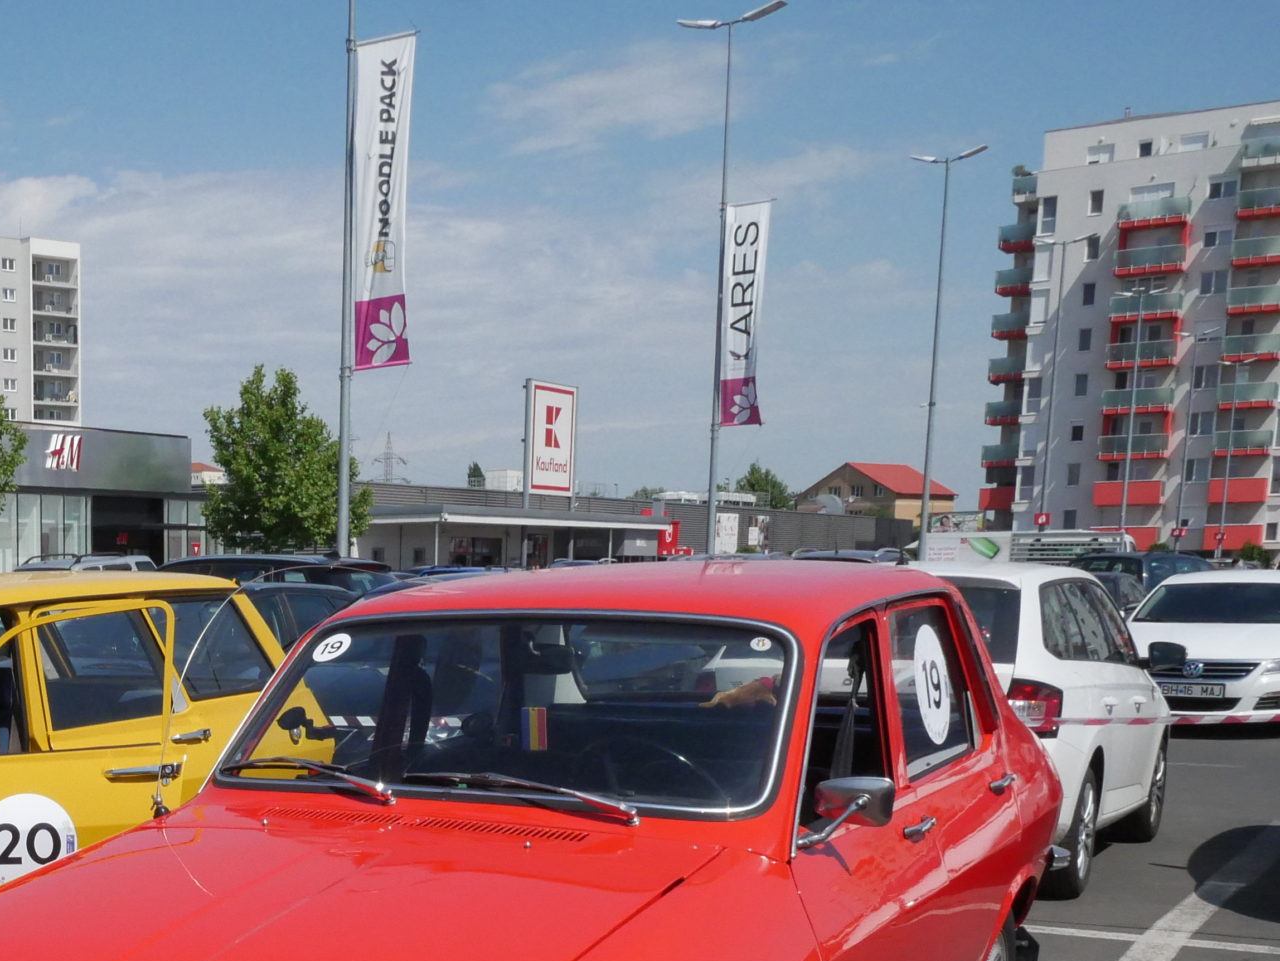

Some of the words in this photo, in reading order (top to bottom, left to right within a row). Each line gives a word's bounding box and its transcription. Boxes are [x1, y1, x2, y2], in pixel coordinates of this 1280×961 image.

[379, 58, 398, 123] PACK
[378, 130, 396, 238] NOODLE
[729, 221, 760, 337] ARES
[44, 433, 82, 472] H&M
[535, 456, 568, 473] Kaufland
[320, 640, 344, 655] 19
[922, 659, 942, 710] 19
[1162, 684, 1178, 695] BH
